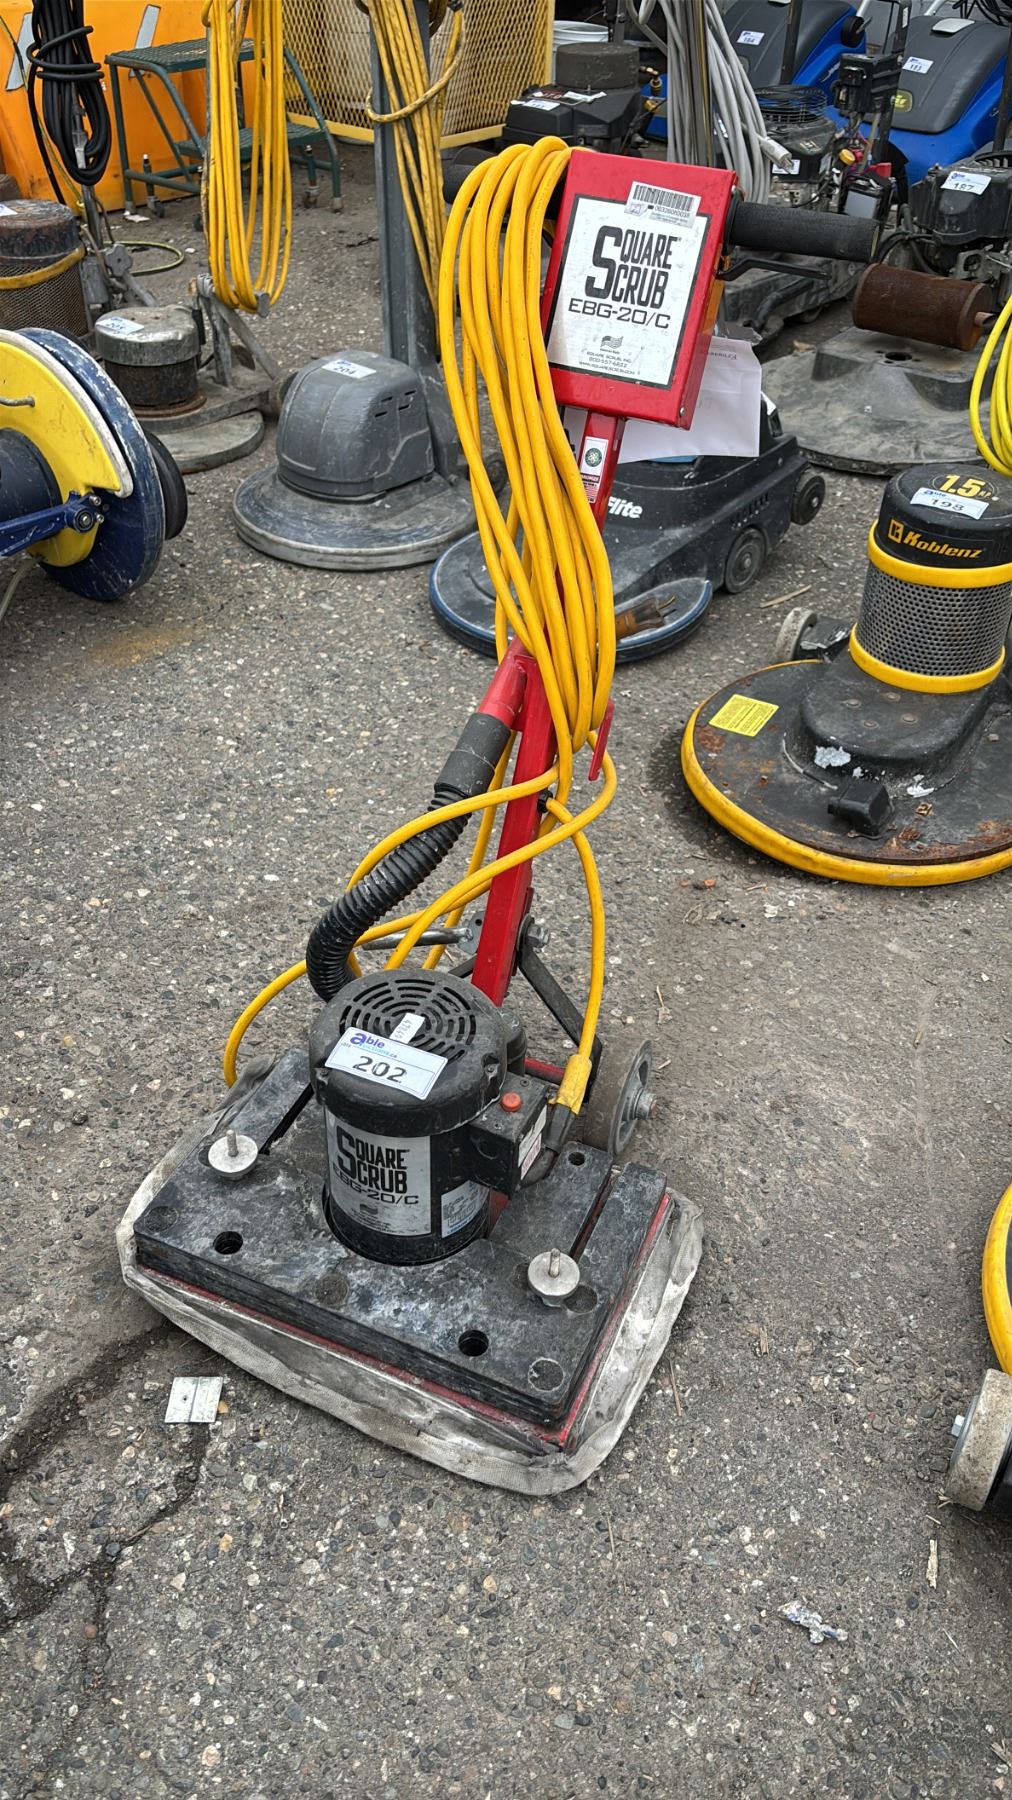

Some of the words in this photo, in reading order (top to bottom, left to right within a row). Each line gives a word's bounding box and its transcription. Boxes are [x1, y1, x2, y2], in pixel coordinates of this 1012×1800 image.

[592, 225, 679, 270] SQUARE
[584, 256, 669, 309] SCRUB
[568, 298, 671, 329] EBG-20/C
[940, 474, 986, 498] 1.5
[931, 498, 965, 512] 198
[903, 531, 983, 558] Koblenz
[350, 1032, 386, 1049] able
[352, 1055, 408, 1083] 202
[336, 1125, 410, 1170] SQUARE
[337, 1155, 408, 1195] SCRUB
